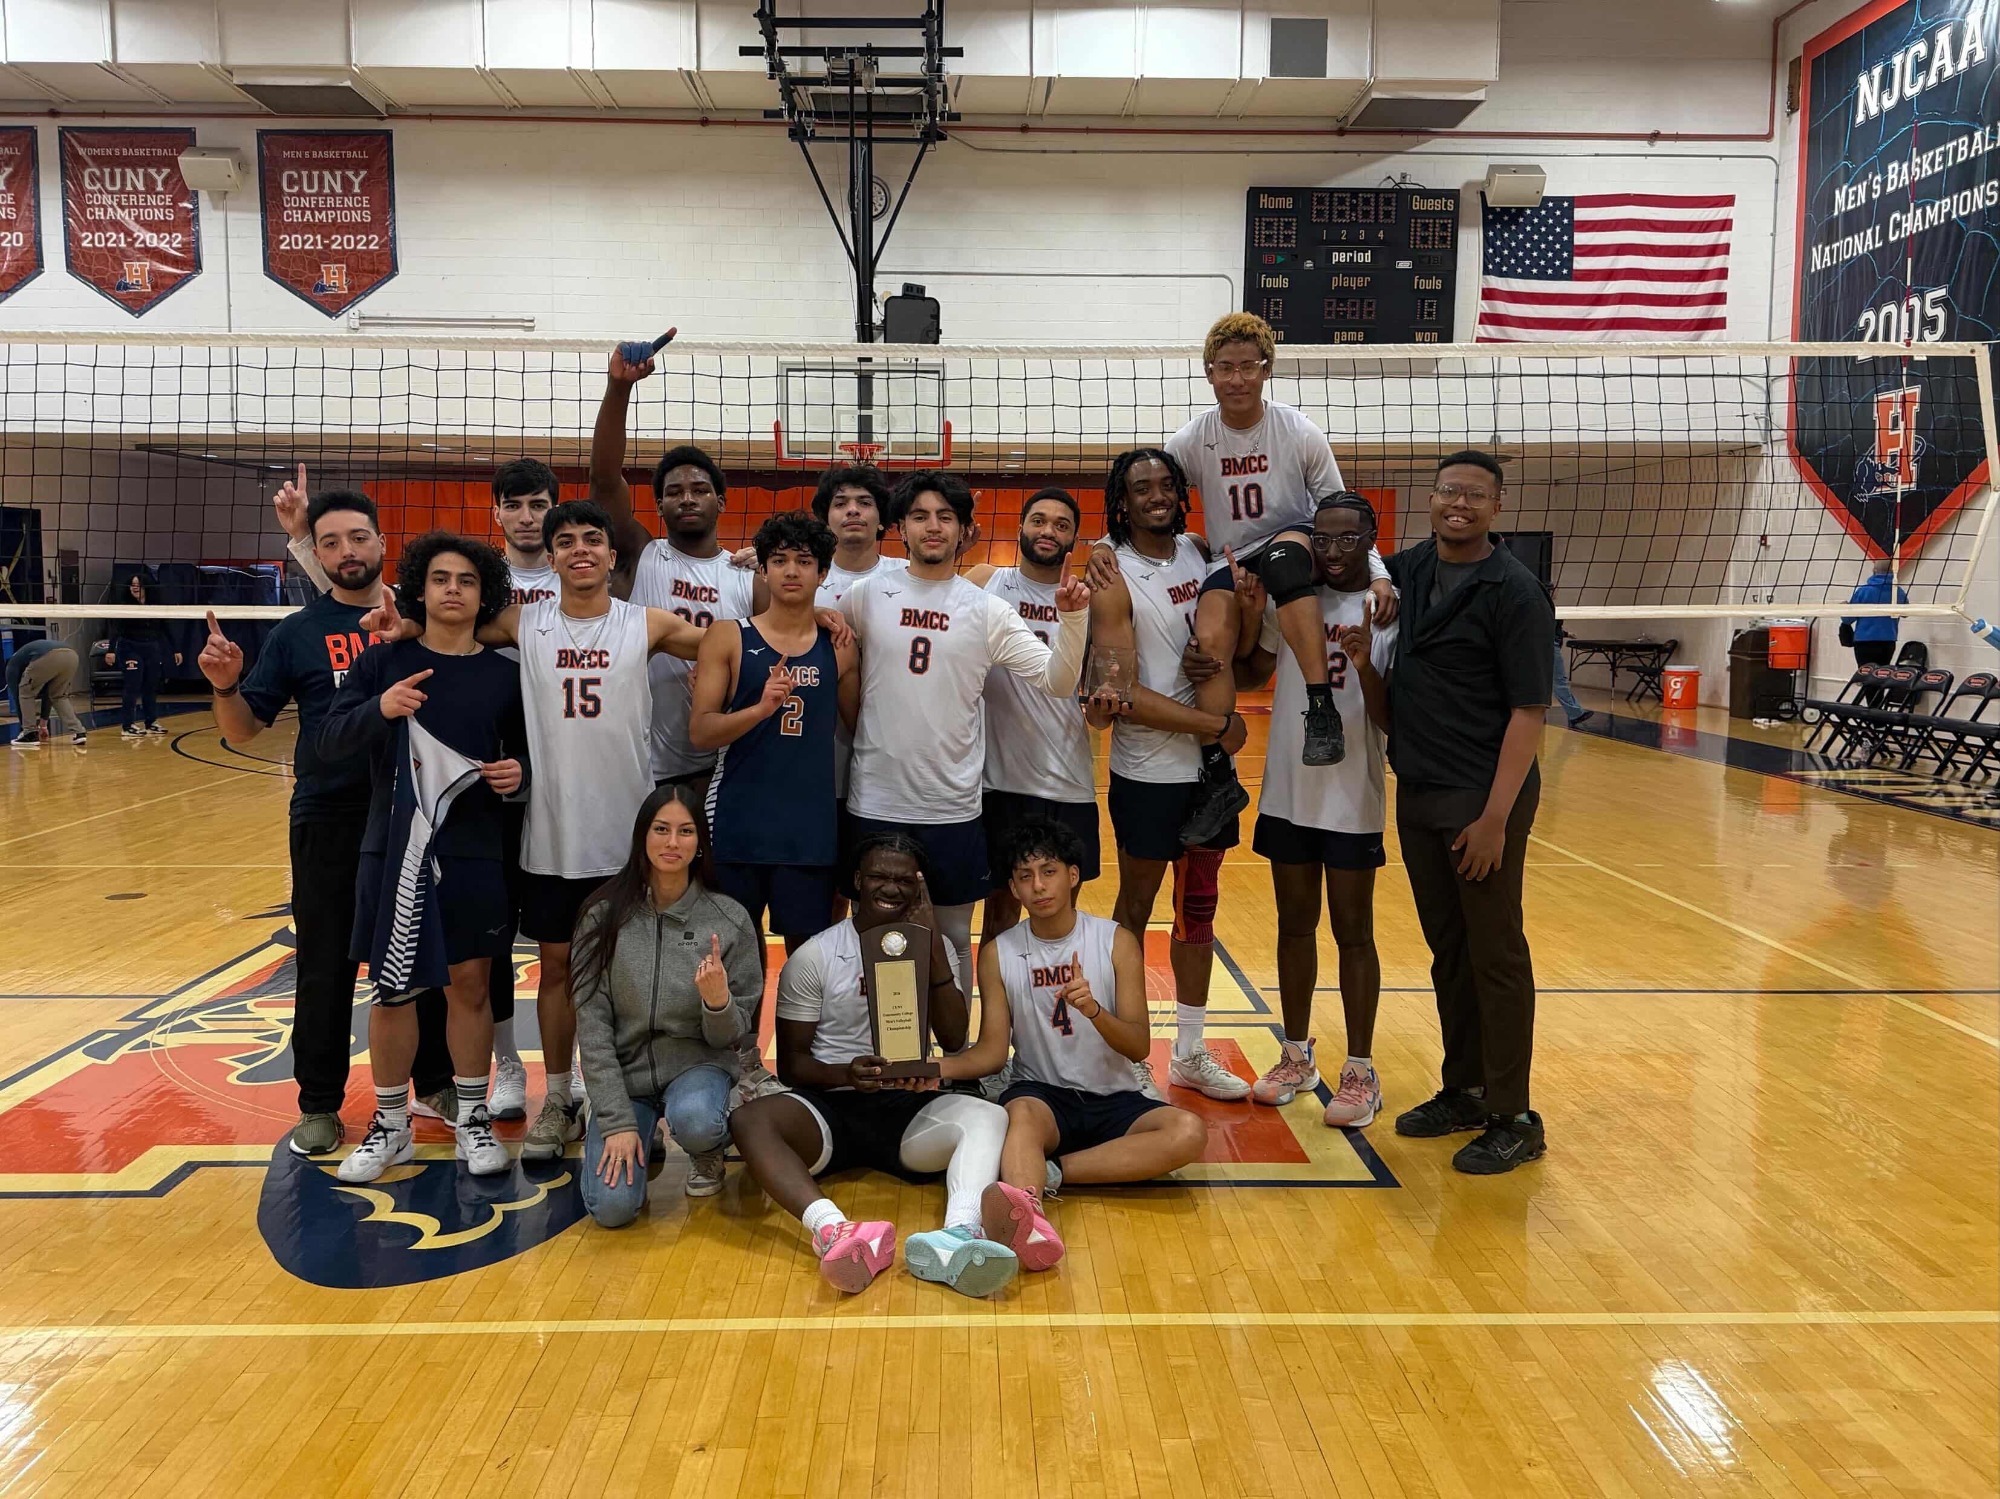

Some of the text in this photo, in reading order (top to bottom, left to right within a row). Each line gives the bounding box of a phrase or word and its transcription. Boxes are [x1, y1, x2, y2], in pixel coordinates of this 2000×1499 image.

[1855, 12, 1987, 128] NJCAA
[122, 148, 179, 156] BASKETBALL
[312, 150, 369, 159] BASKETBALL
[83, 168, 171, 191] CUNY
[282, 170, 368, 194] CUNY
[85, 194, 173, 206] CONFERENCE
[283, 196, 370, 208] CONFERENCE
[1259, 193, 1293, 209] Home
[1412, 195, 1454, 211] Guests
[1833, 172, 1881, 218] MEN'S
[86, 208, 175, 221] CHAMPIONS
[283, 210, 372, 223] CHAMPIONS
[1340, 229, 1347, 240] 2
[1359, 229, 1365, 240] 3
[1378, 229, 1384, 240] 4
[1811, 179, 1998, 273] NATIONAL CHAMPIONS
[81, 231, 183, 248] 2021-2022
[279, 234, 380, 250] 2021-2022
[1331, 249, 1371, 265] period
[1260, 273, 1289, 289] fouls
[1331, 273, 1371, 290] player
[1414, 275, 1442, 290] fouls
[1856, 284, 1949, 362] 2005
[1270, 330, 1284, 341] on
[1334, 331, 1364, 344] game
[1415, 331, 1438, 342] won
[1221, 454, 1269, 478] BMCC
[1228, 483, 1264, 521] 10
[672, 579, 719, 604] BMCC
[900, 608, 950, 632] BMCC
[1184, 608, 1198, 636] 1
[556, 648, 610, 670] BMCC
[908, 635, 932, 676] 8
[768, 665, 820, 687] MCC
[562, 677, 602, 719] 15
[780, 695, 805, 737] 2
[1052, 997, 1074, 1036] 4
